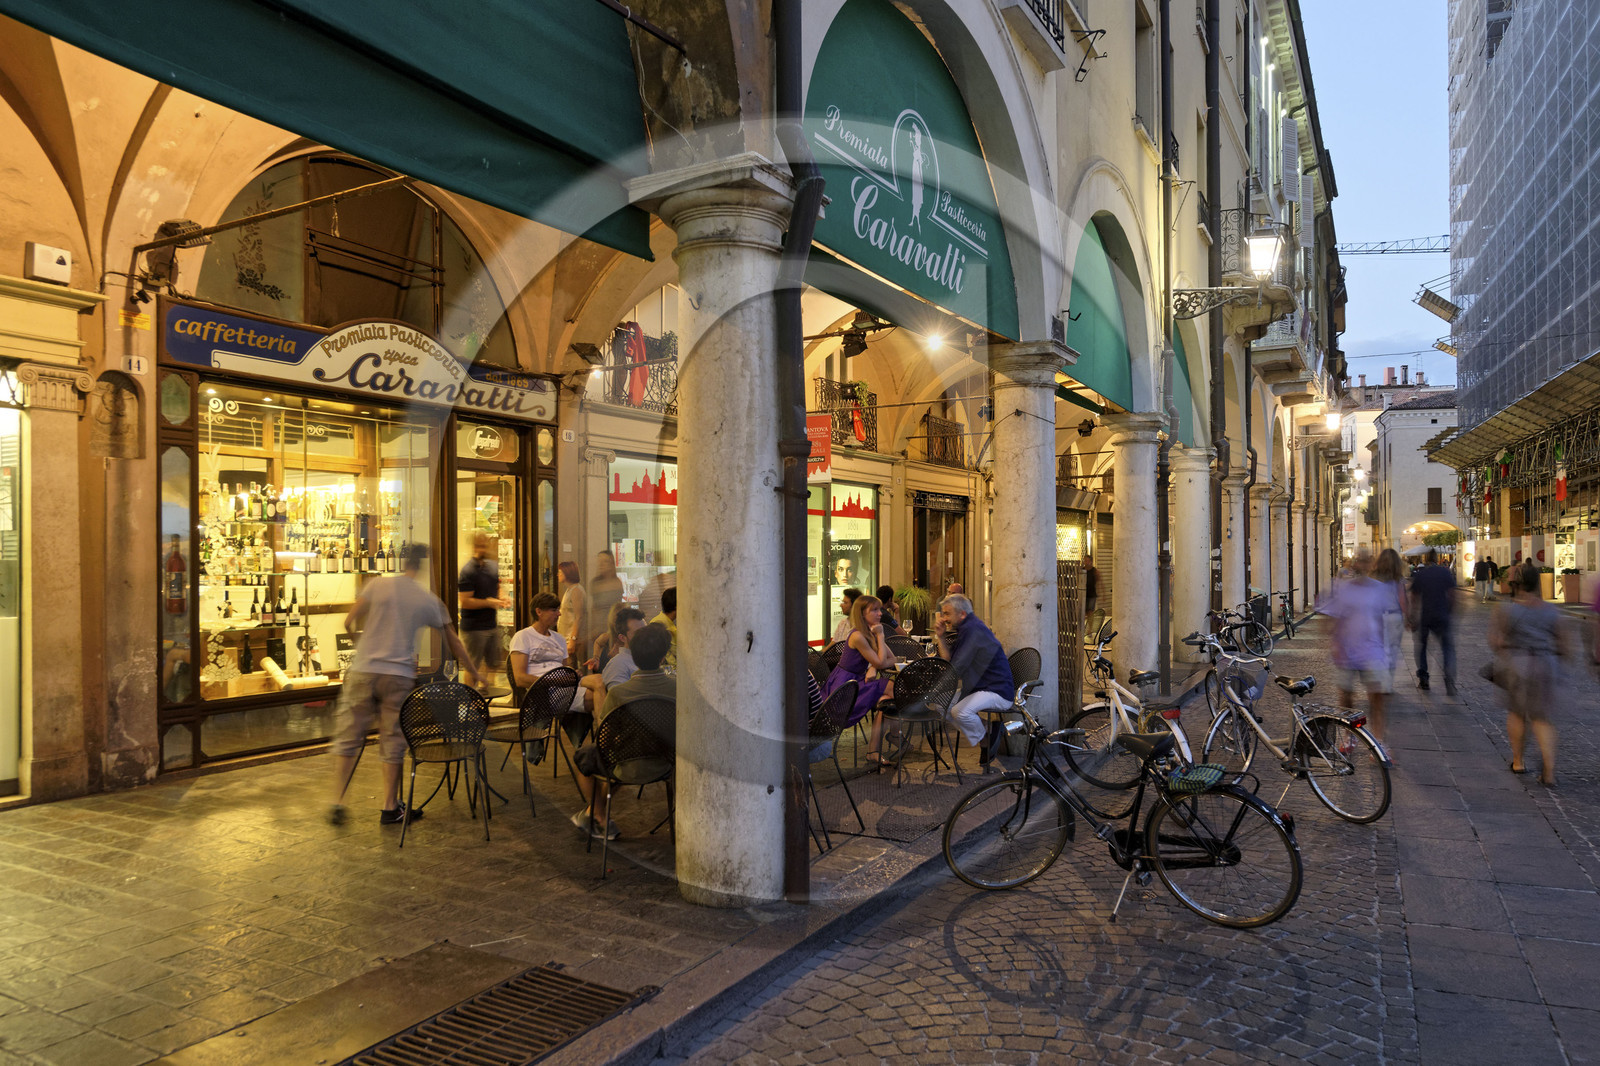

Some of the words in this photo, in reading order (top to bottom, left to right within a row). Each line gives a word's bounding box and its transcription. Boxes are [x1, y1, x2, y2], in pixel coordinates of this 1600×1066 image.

[824, 105, 889, 169] Premiata
[850, 176, 966, 294] Caravatti
[940, 190, 987, 242] Pasticceria
[174, 318, 297, 355] caffetteria
[320, 324, 388, 358] Premiata
[389, 325, 463, 380] Pasticceria
[383, 349, 419, 366] tipica
[128, 358, 141, 371] 14
[312, 352, 547, 417] Caravatti
[486, 371, 503, 384] dal
